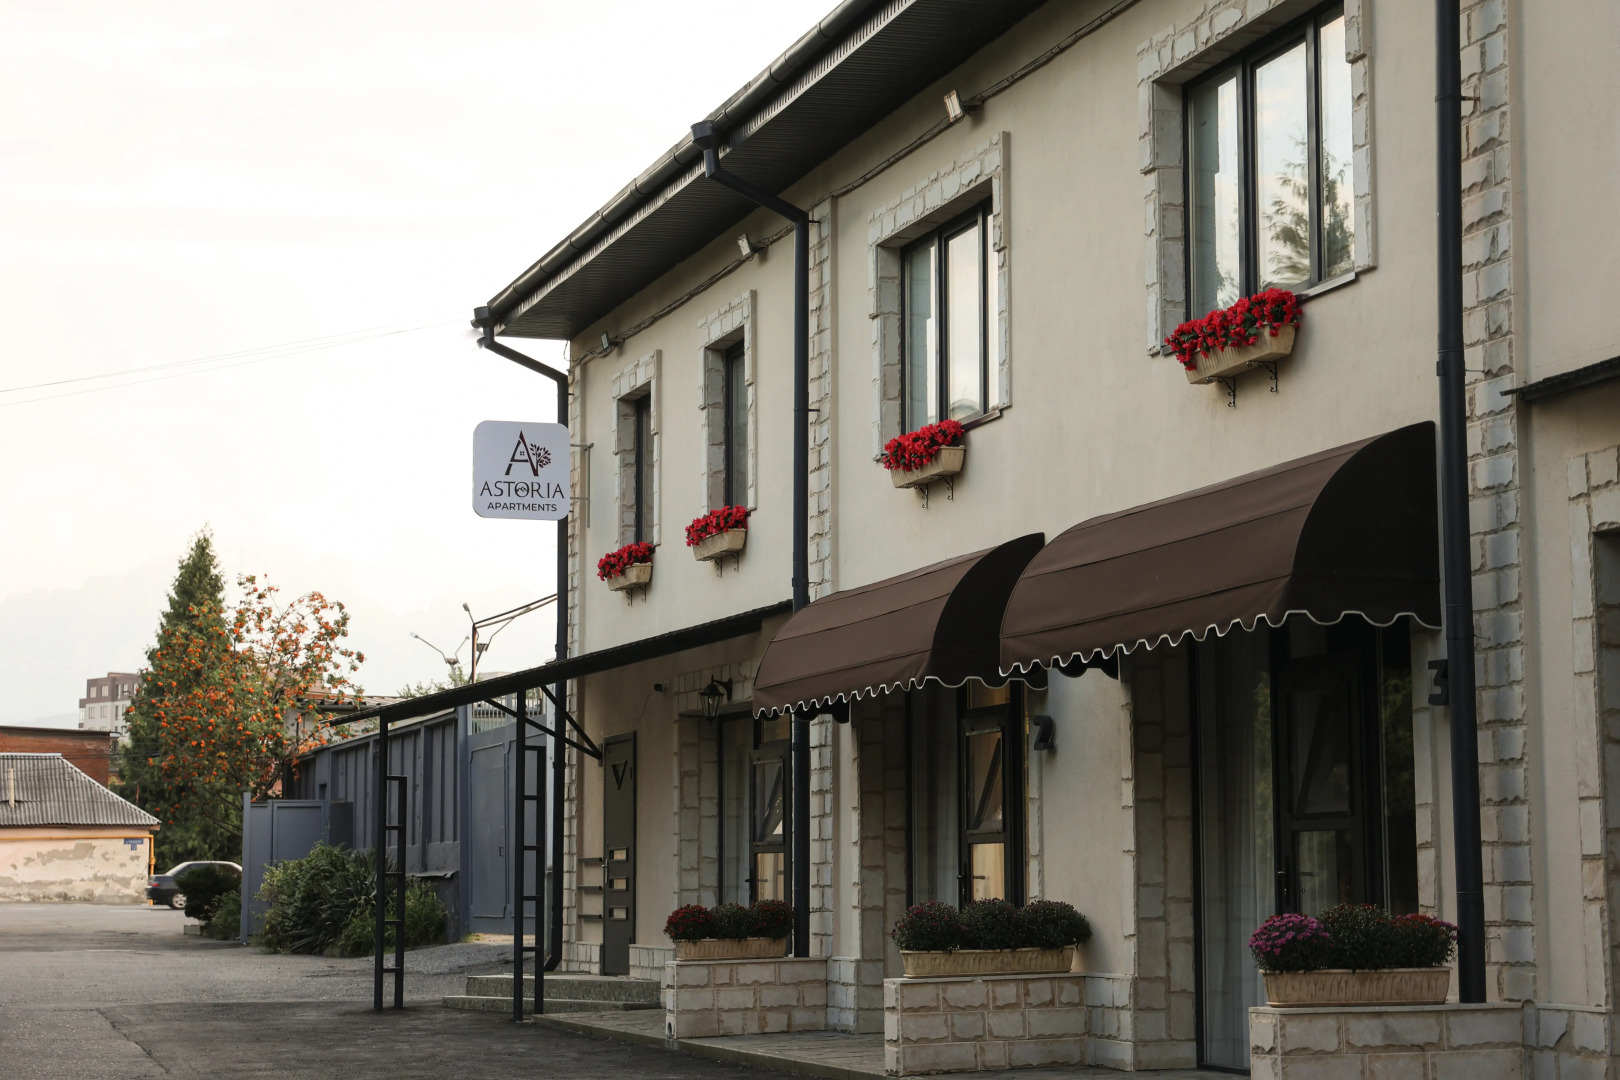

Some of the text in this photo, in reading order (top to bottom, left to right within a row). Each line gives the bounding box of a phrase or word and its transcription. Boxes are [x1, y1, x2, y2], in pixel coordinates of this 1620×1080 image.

[504, 430, 539, 477] A
[479, 480, 565, 499] ASTORIA
[487, 502, 558, 512] APARTMENTS
[1427, 658, 1449, 707] 3
[1032, 714, 1055, 751] 2
